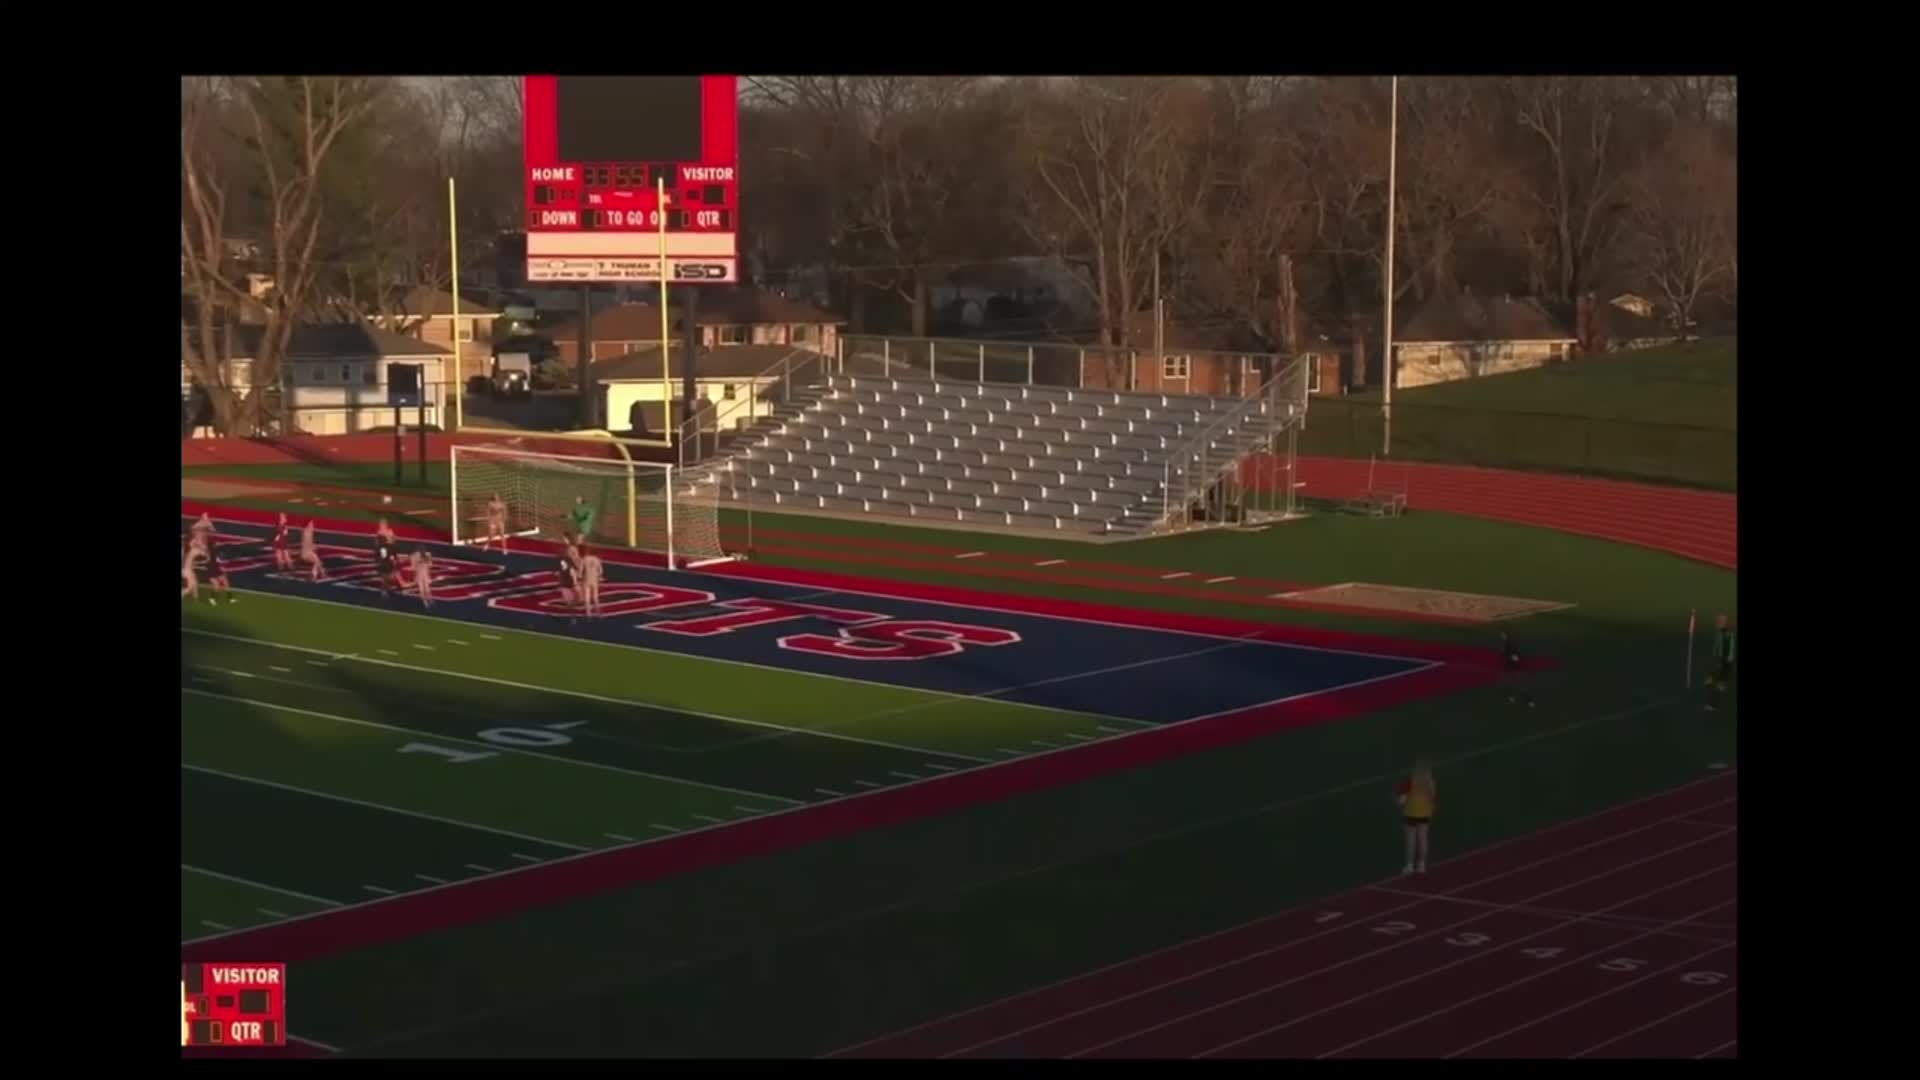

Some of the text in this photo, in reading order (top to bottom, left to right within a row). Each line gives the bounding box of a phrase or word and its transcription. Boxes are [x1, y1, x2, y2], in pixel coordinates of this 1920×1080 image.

[531, 167, 575, 181] HOME
[683, 167, 734, 181] VISITOR
[542, 211, 576, 225] DOWN
[607, 211, 623, 225] TO
[627, 211, 644, 225] GO
[697, 211, 720, 228] QTR
[1314, 911, 1729, 986] 1 2 3 4 5 6
